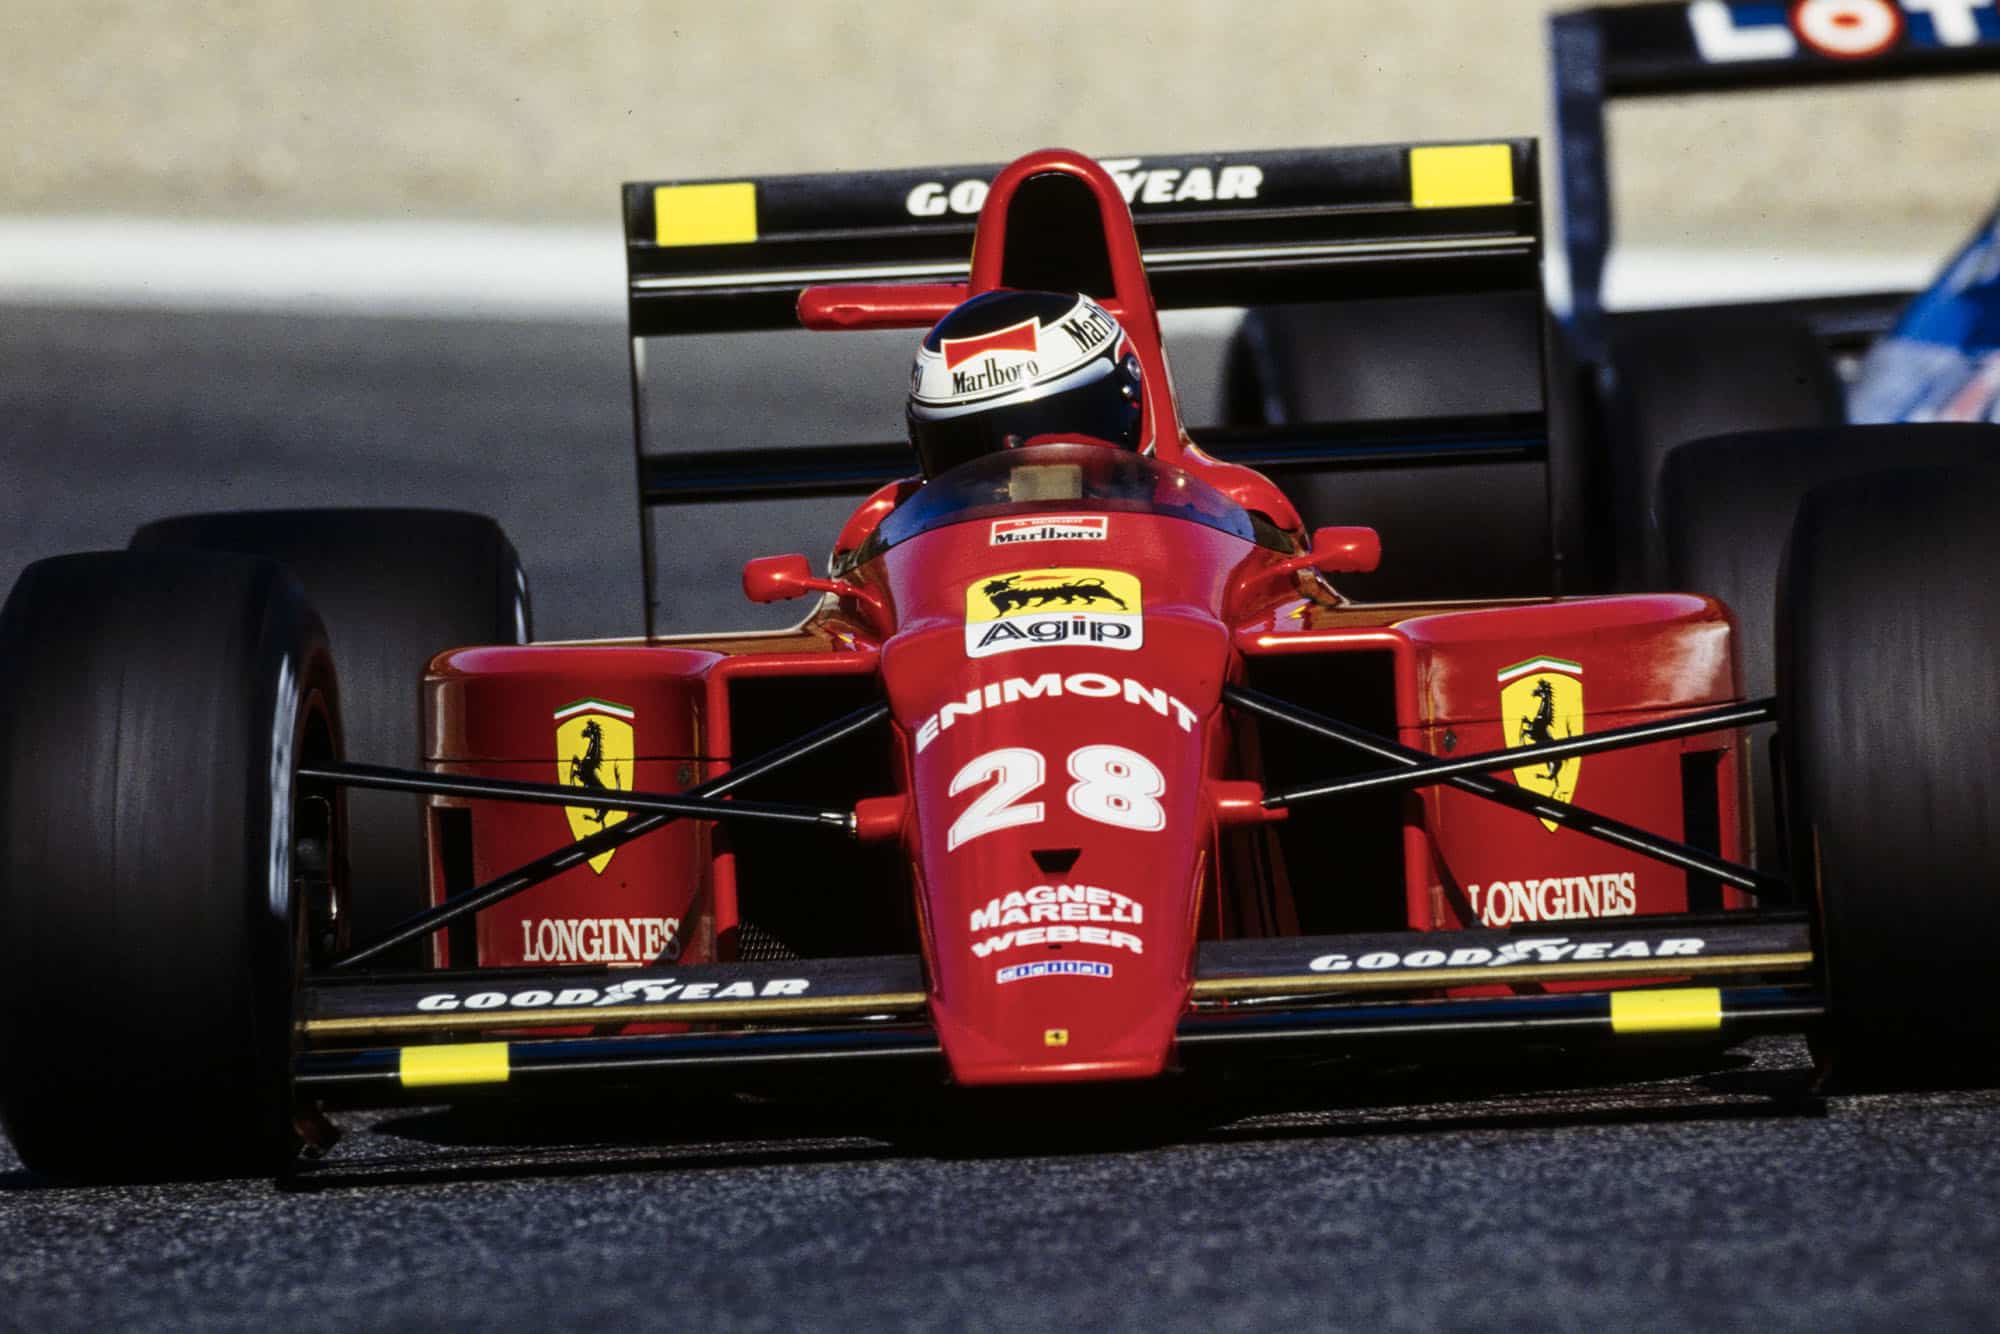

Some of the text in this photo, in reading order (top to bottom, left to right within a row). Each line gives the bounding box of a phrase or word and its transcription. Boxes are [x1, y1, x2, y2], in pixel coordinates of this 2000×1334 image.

[906, 160, 1263, 216] GOYEAR
[951, 357, 1040, 395] Marlboro
[995, 527, 1102, 544] Marlboro
[976, 615, 1132, 650] Agip
[916, 673, 1198, 754] ENIMONT
[947, 744, 1166, 852] 28
[970, 885, 1143, 931] MAGNETI
[1468, 872, 1637, 927] LONGINES
[522, 918, 681, 962] LONGINES
[971, 925, 1143, 957] WEBER
[1309, 938, 1705, 971] GOODYEAR
[416, 978, 810, 1011] GOODYEAR
